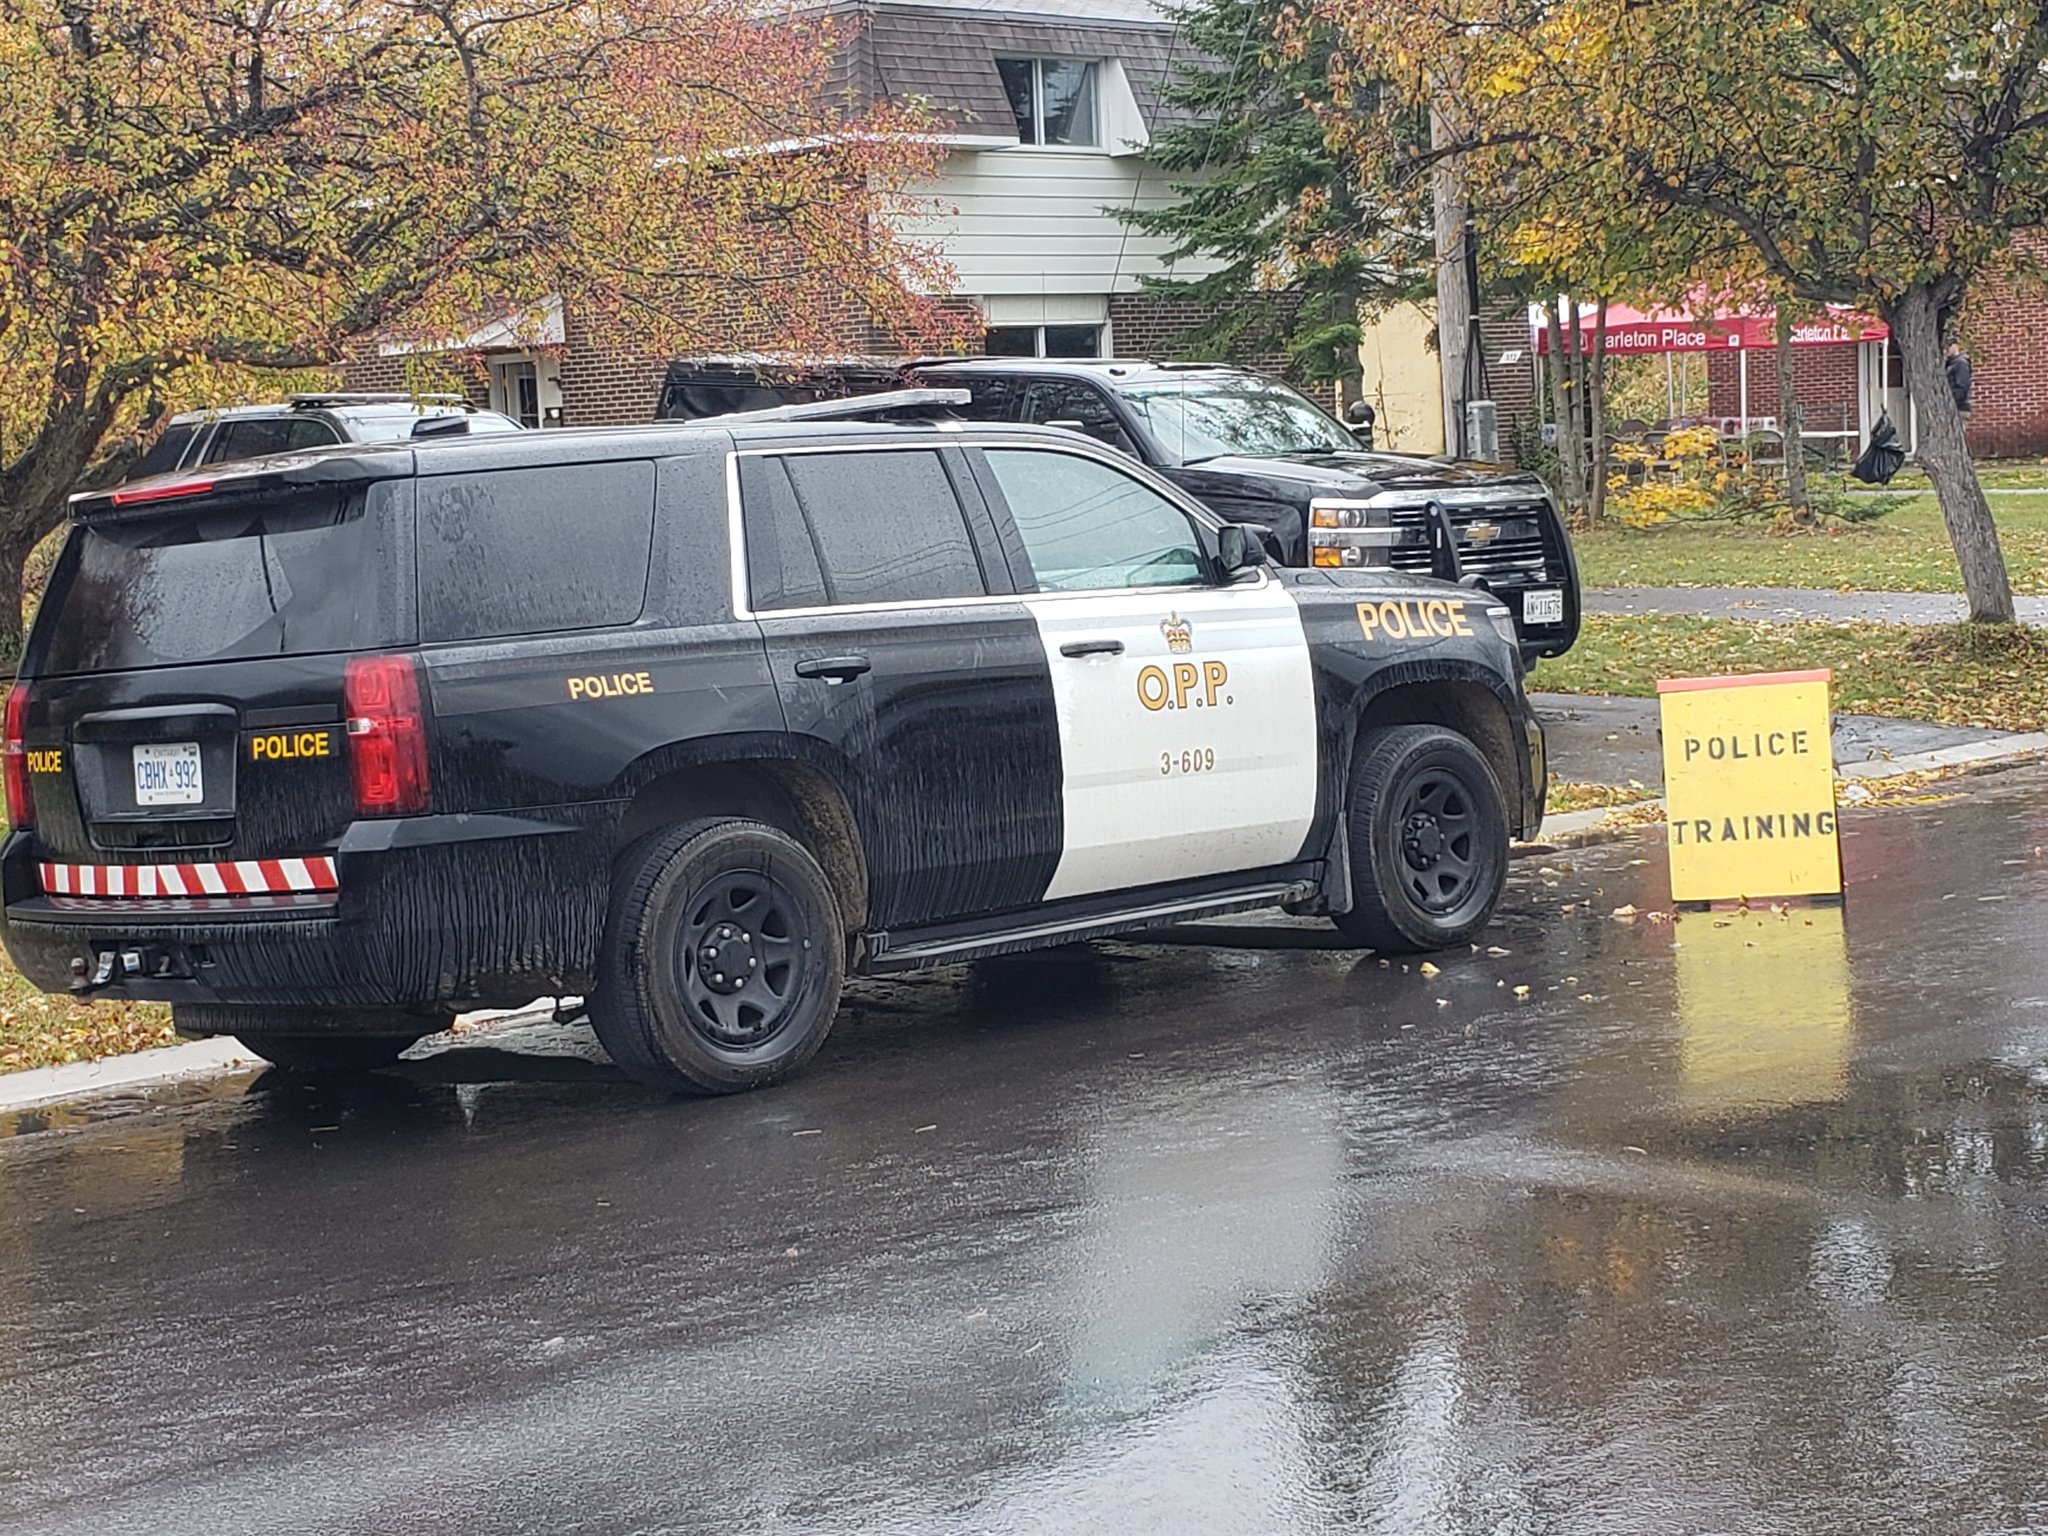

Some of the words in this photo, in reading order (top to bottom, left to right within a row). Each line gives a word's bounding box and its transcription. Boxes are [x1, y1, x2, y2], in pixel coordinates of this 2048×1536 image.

[1594, 331, 1657, 348] arleton
[1662, 329, 1706, 346] Place
[1356, 600, 1474, 641] POLICE
[567, 672, 654, 700] POLICE
[1137, 661, 1233, 711] O.P.P.
[252, 732, 330, 760] POLICE
[1685, 731, 1809, 762] POLICE
[27, 750, 62, 773] POLICE
[1160, 748, 1215, 775] 3-609
[1672, 811, 1834, 845] TRAINING
